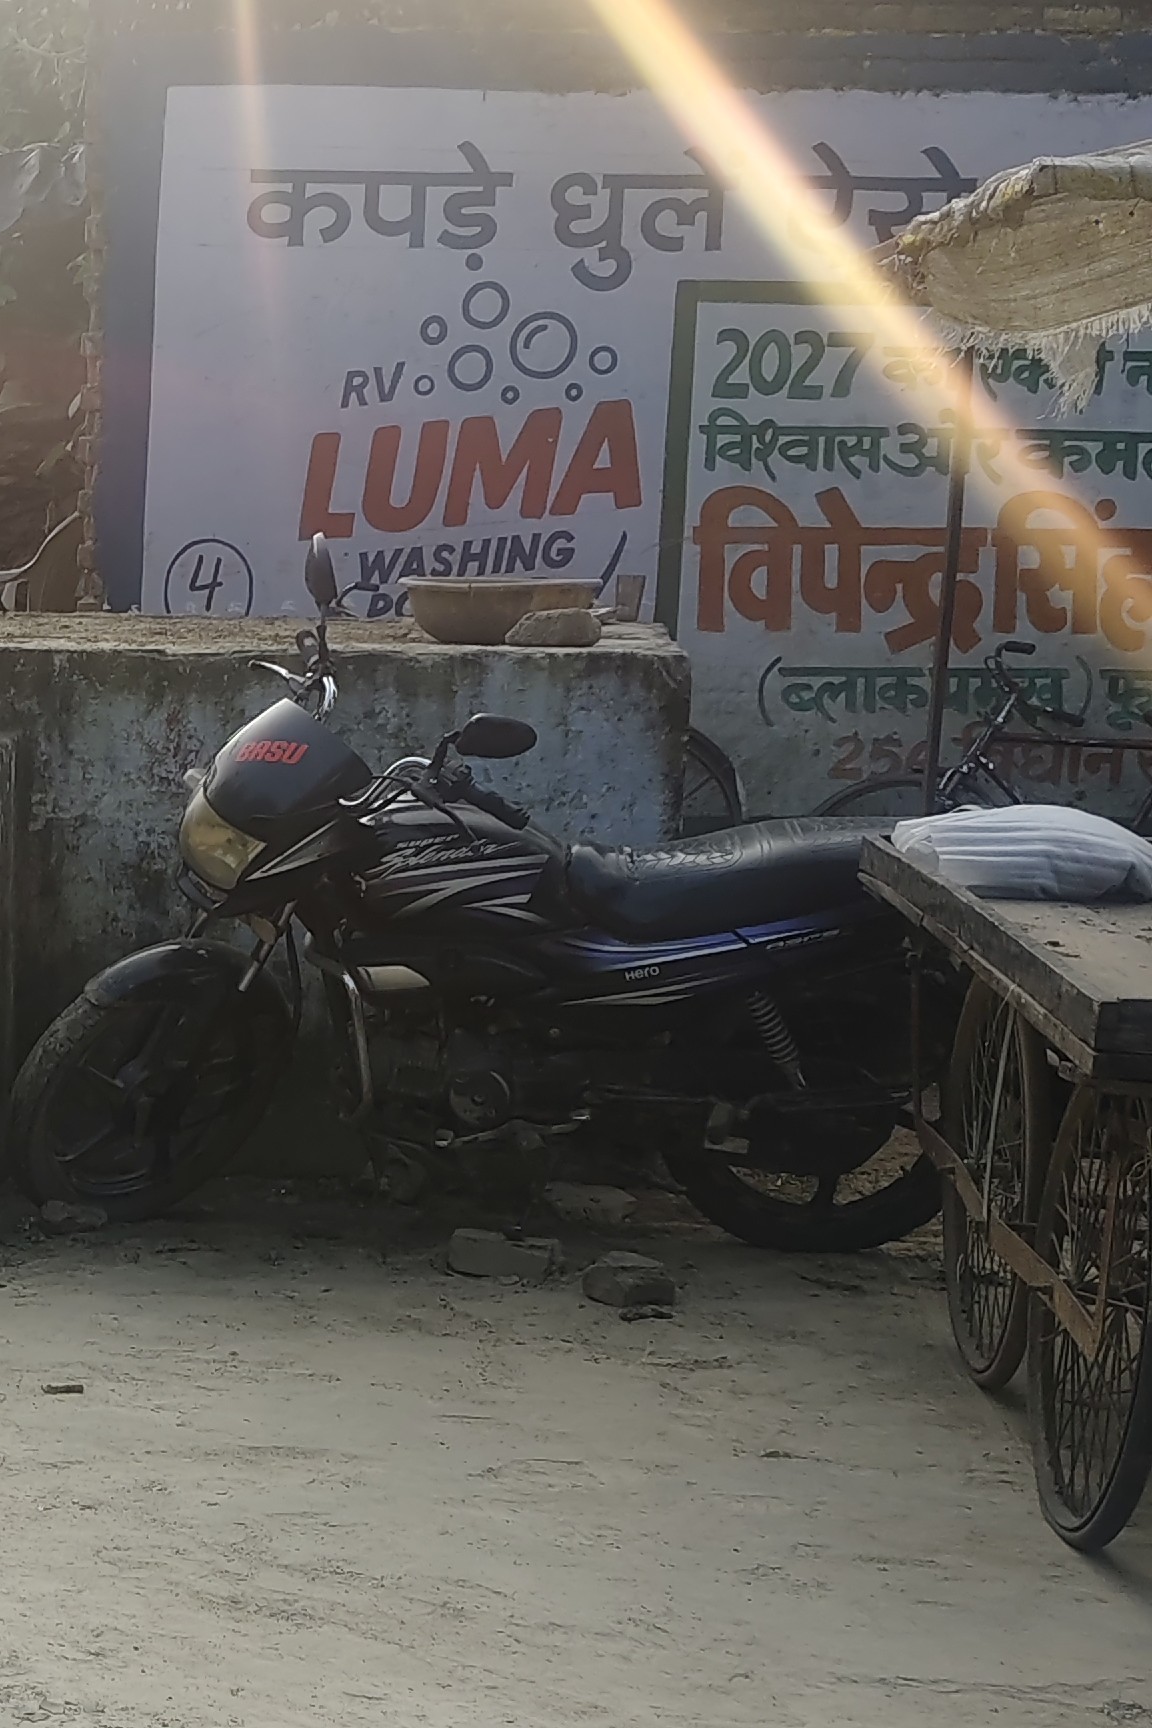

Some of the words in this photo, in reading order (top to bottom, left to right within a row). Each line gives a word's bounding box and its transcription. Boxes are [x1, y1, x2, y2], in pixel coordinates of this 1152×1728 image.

[247, 141, 514, 271] कपड़े
[550, 147, 730, 292] धुले
[340, 361, 406, 409] RV
[711, 328, 877, 400] 2027
[298, 398, 643, 541] LUMA
[699, 407, 890, 482] विश्वास
[1014, 428, 1152, 482] कम
[359, 530, 576, 584] WASHING
